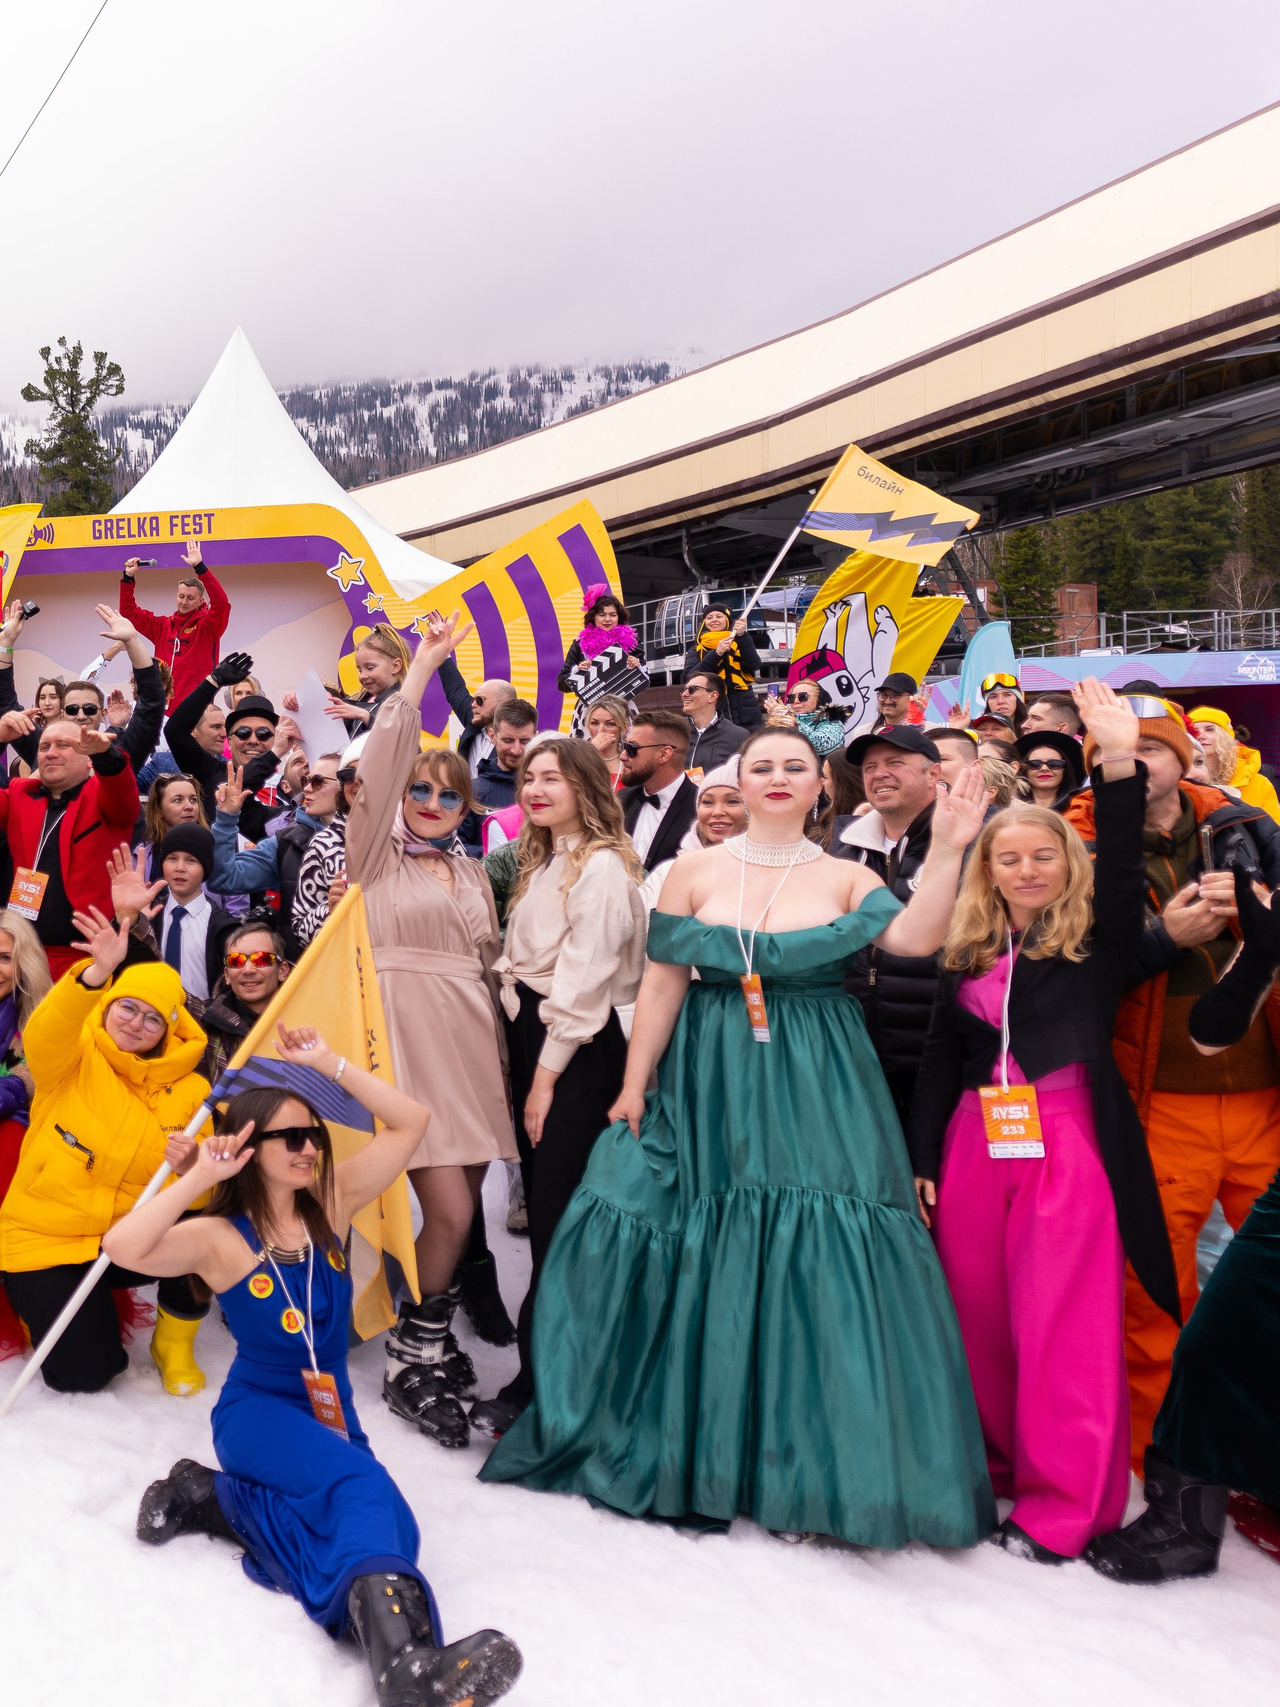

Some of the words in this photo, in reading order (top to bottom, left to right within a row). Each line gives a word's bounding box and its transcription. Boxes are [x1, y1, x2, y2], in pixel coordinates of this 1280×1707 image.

[857, 466, 905, 495] билайн
[91, 517, 160, 541] GRELKA
[169, 512, 215, 537] FEST
[992, 1105, 1030, 1119] AYS!
[1001, 1125, 1026, 1135] 233
